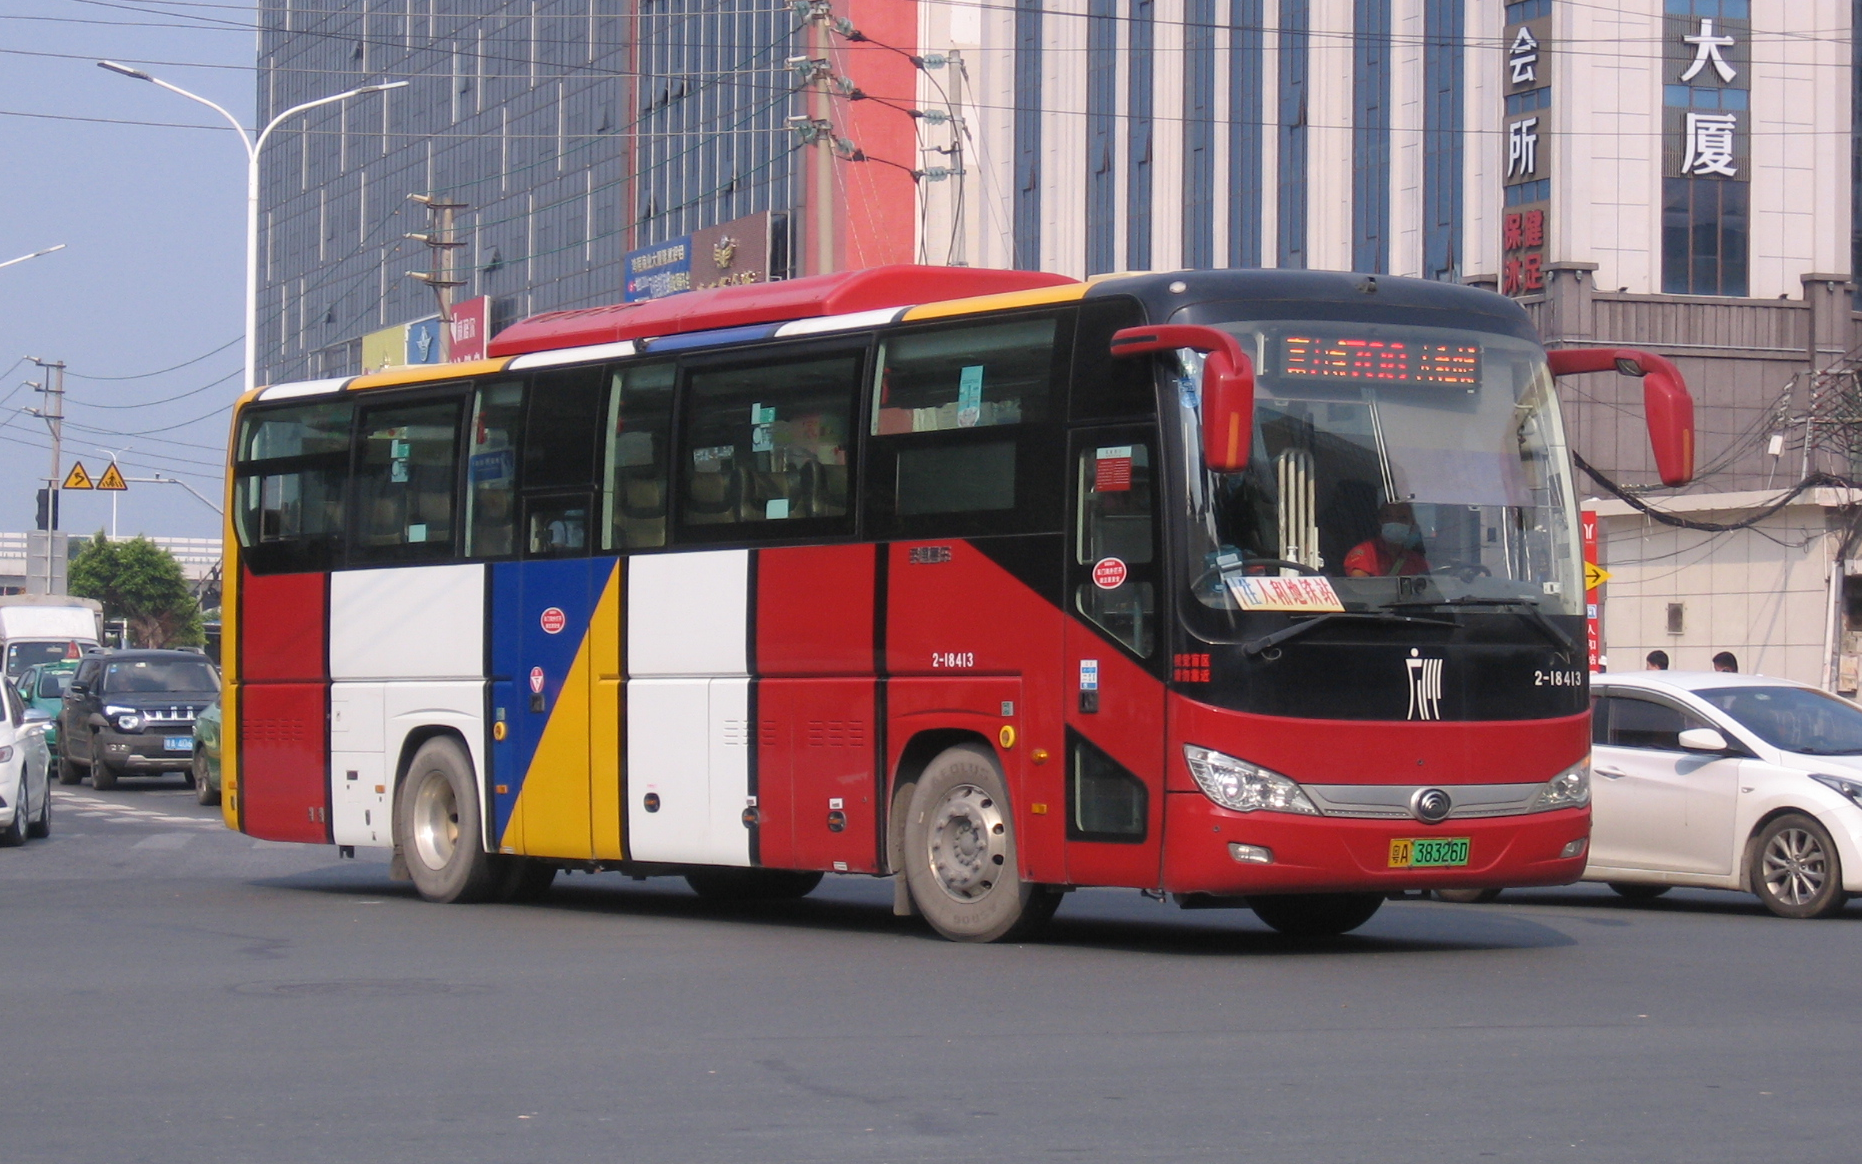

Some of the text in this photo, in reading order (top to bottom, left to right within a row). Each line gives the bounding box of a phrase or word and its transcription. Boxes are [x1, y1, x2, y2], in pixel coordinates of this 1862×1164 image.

[1508, 26, 1538, 178] 会所
[1680, 18, 1738, 177] 大厦
[1504, 210, 1544, 250] 保健
[932, 652, 974, 668] 2-18413
[1534, 670, 1582, 686] 2-18413
